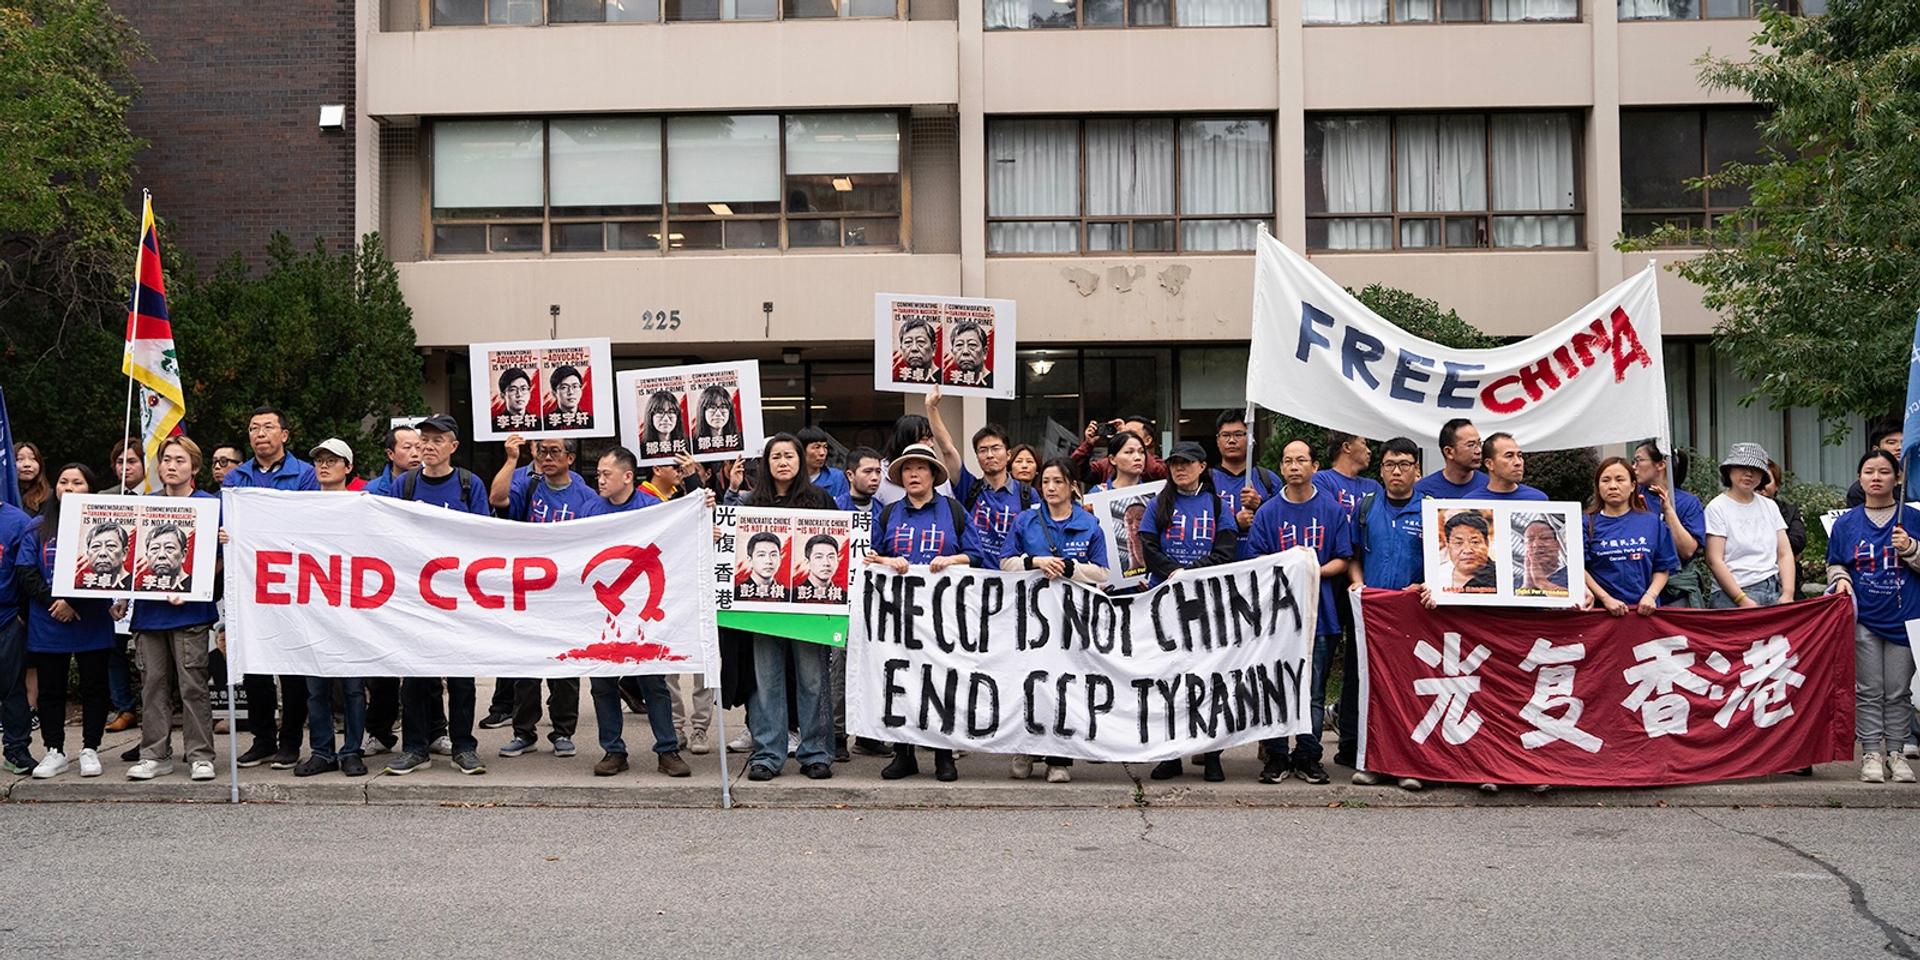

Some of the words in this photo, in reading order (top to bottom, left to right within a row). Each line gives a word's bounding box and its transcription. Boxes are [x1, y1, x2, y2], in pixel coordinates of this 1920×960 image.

[948, 303, 991, 312] COMMEMORATING
[642, 310, 681, 330] 225
[922, 315, 941, 323] CRIME
[973, 318, 993, 326] CRIME
[496, 355, 532, 364] ADVOCACY
[548, 352, 584, 361] ADVOCACY
[570, 360, 589, 368] CRIME
[1296, 300, 1485, 409] FREE
[1480, 305, 1653, 414] CHINA
[519, 362, 537, 370] CRIME
[640, 375, 682, 383] COMMEMORATING
[692, 370, 734, 378] COMMEMORATING
[899, 367, 936, 382] 李卓人
[950, 369, 987, 386] 李卓人
[114, 518, 136, 526] CRIME
[173, 520, 194, 528] CRIME
[740, 516, 772, 524] DEMOCRATIC
[773, 517, 790, 525] CHOICE
[974, 500, 1017, 534] 自由
[770, 525, 787, 533] CRIME
[827, 527, 845, 536] CRIME
[1166, 509, 1216, 543] 自由
[1279, 516, 1325, 551] 自由
[895, 523, 945, 555] 自由
[850, 512, 872, 586] 時代
[714, 507, 736, 609] 光復香港
[82, 572, 125, 589] 李卓人
[142, 574, 185, 590] 李卓人
[255, 550, 396, 609] END
[419, 555, 558, 611] CCP
[932, 576, 1003, 653] CCP
[1017, 578, 1050, 652] IS
[1061, 583, 1135, 657] NOT
[1150, 566, 1303, 652] CHINA
[1411, 632, 1806, 754] 光复香港
[882, 659, 1000, 738] END
[1024, 671, 1114, 741] CCP
[1130, 658, 1305, 744] TYRANNY
